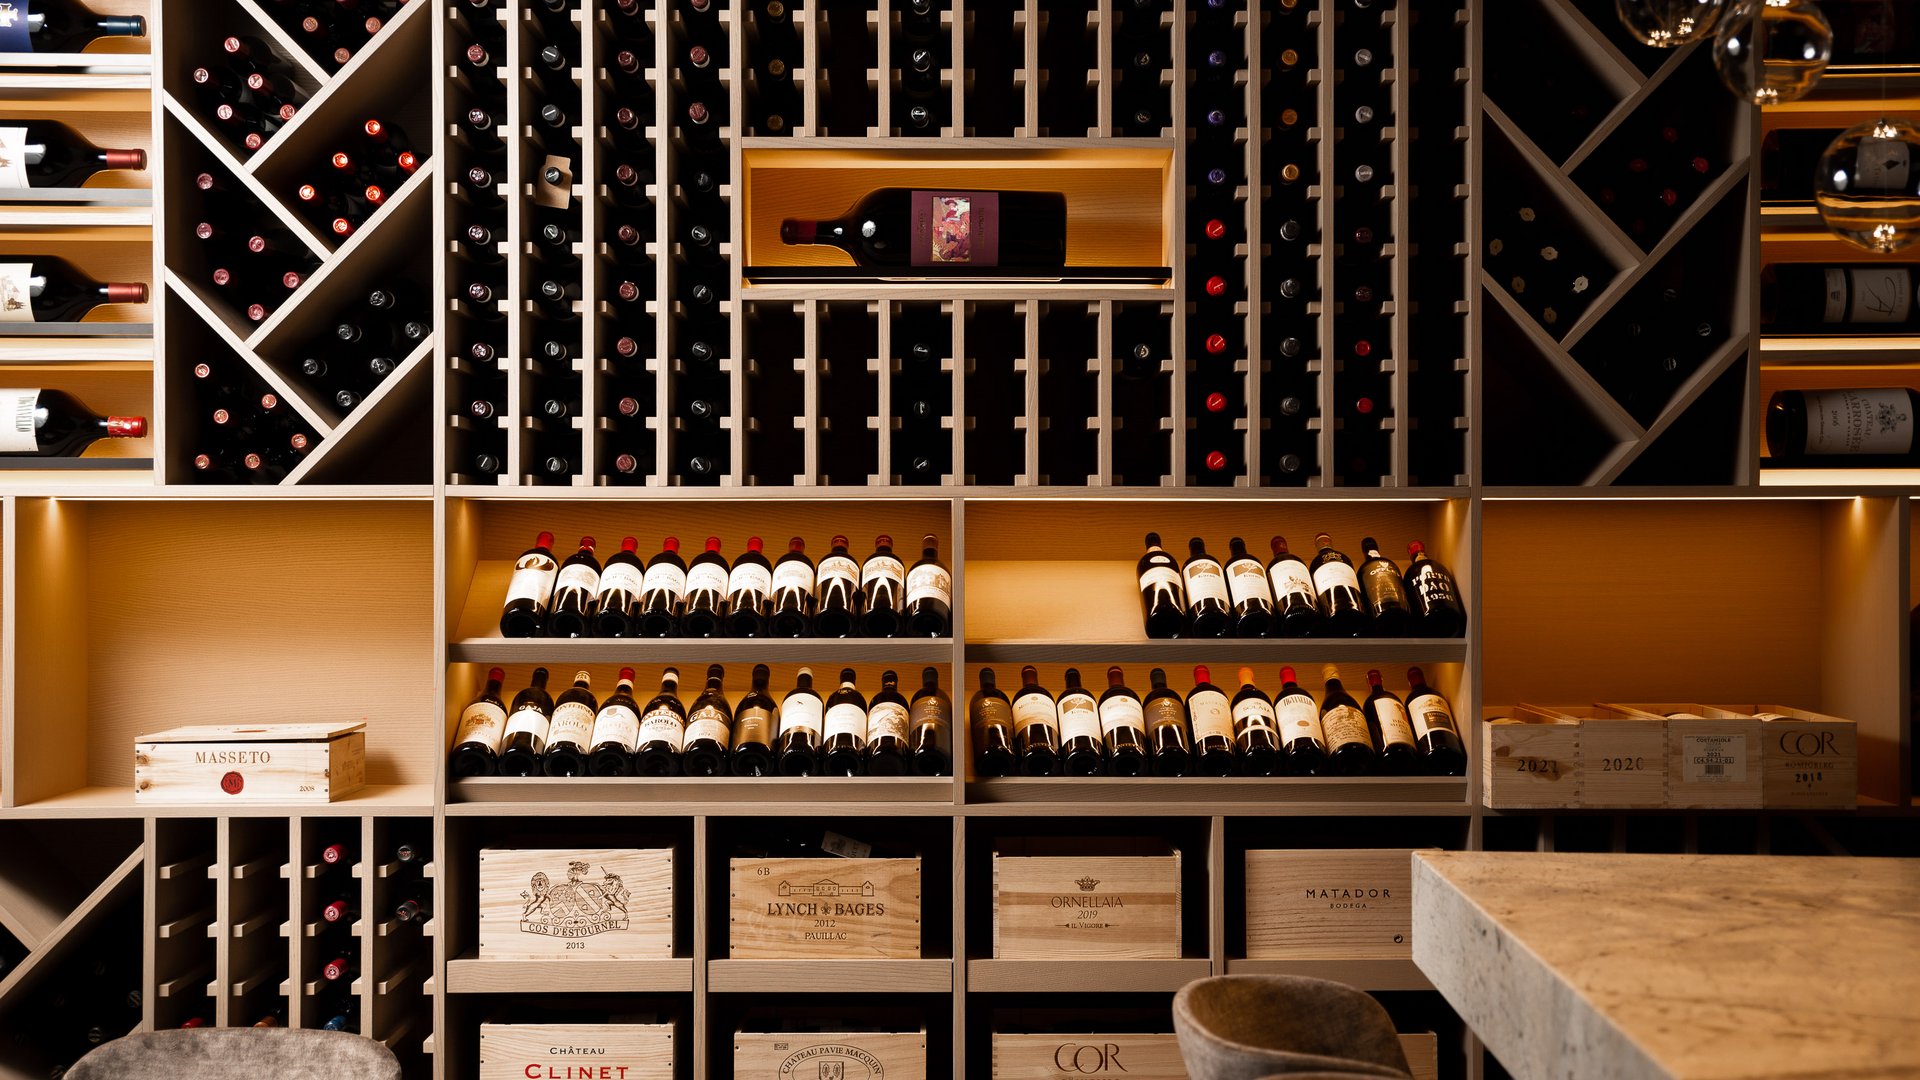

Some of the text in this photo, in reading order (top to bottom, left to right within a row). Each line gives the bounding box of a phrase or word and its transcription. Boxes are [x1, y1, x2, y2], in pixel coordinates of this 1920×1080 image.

[1780, 731, 1840, 757] COR
[195, 751, 271, 763] MASSETO
[1602, 757, 1644, 771] 2020
[757, 867, 770, 876] 6B
[1306, 889, 1391, 898] MATADOR
[1051, 896, 1123, 908] ORNELLAIA
[767, 903, 885, 916] LYNCH BAGES
[1077, 910, 1098, 919] 2019
[528, 920, 621, 937] COS D'ESTOURNEL
[804, 932, 847, 940] PAUILLAC
[549, 1045, 605, 1055] CHÂTEAU
[782, 1047, 882, 1075] CHATEAU PAVIE MACQUIN
[1054, 1043, 1128, 1074] COR
[525, 1063, 629, 1079] CLINET
